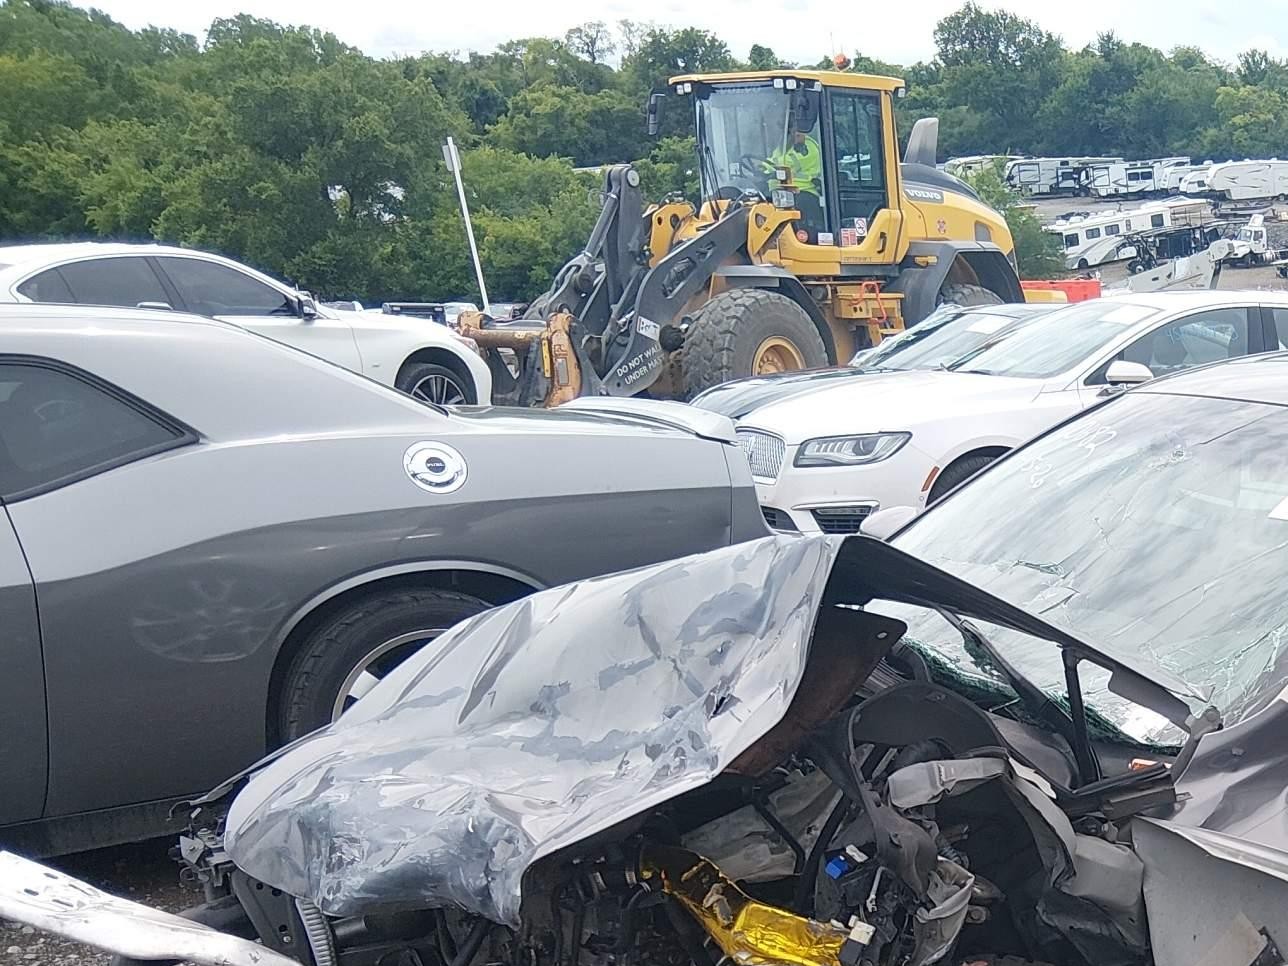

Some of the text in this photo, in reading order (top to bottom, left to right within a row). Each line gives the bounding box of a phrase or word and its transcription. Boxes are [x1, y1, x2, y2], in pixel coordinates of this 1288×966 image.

[905, 189, 941, 199] VOLVO
[617, 365, 629, 377] DO
[629, 353, 644, 370] NOT
[624, 366, 648, 385] UNDER
